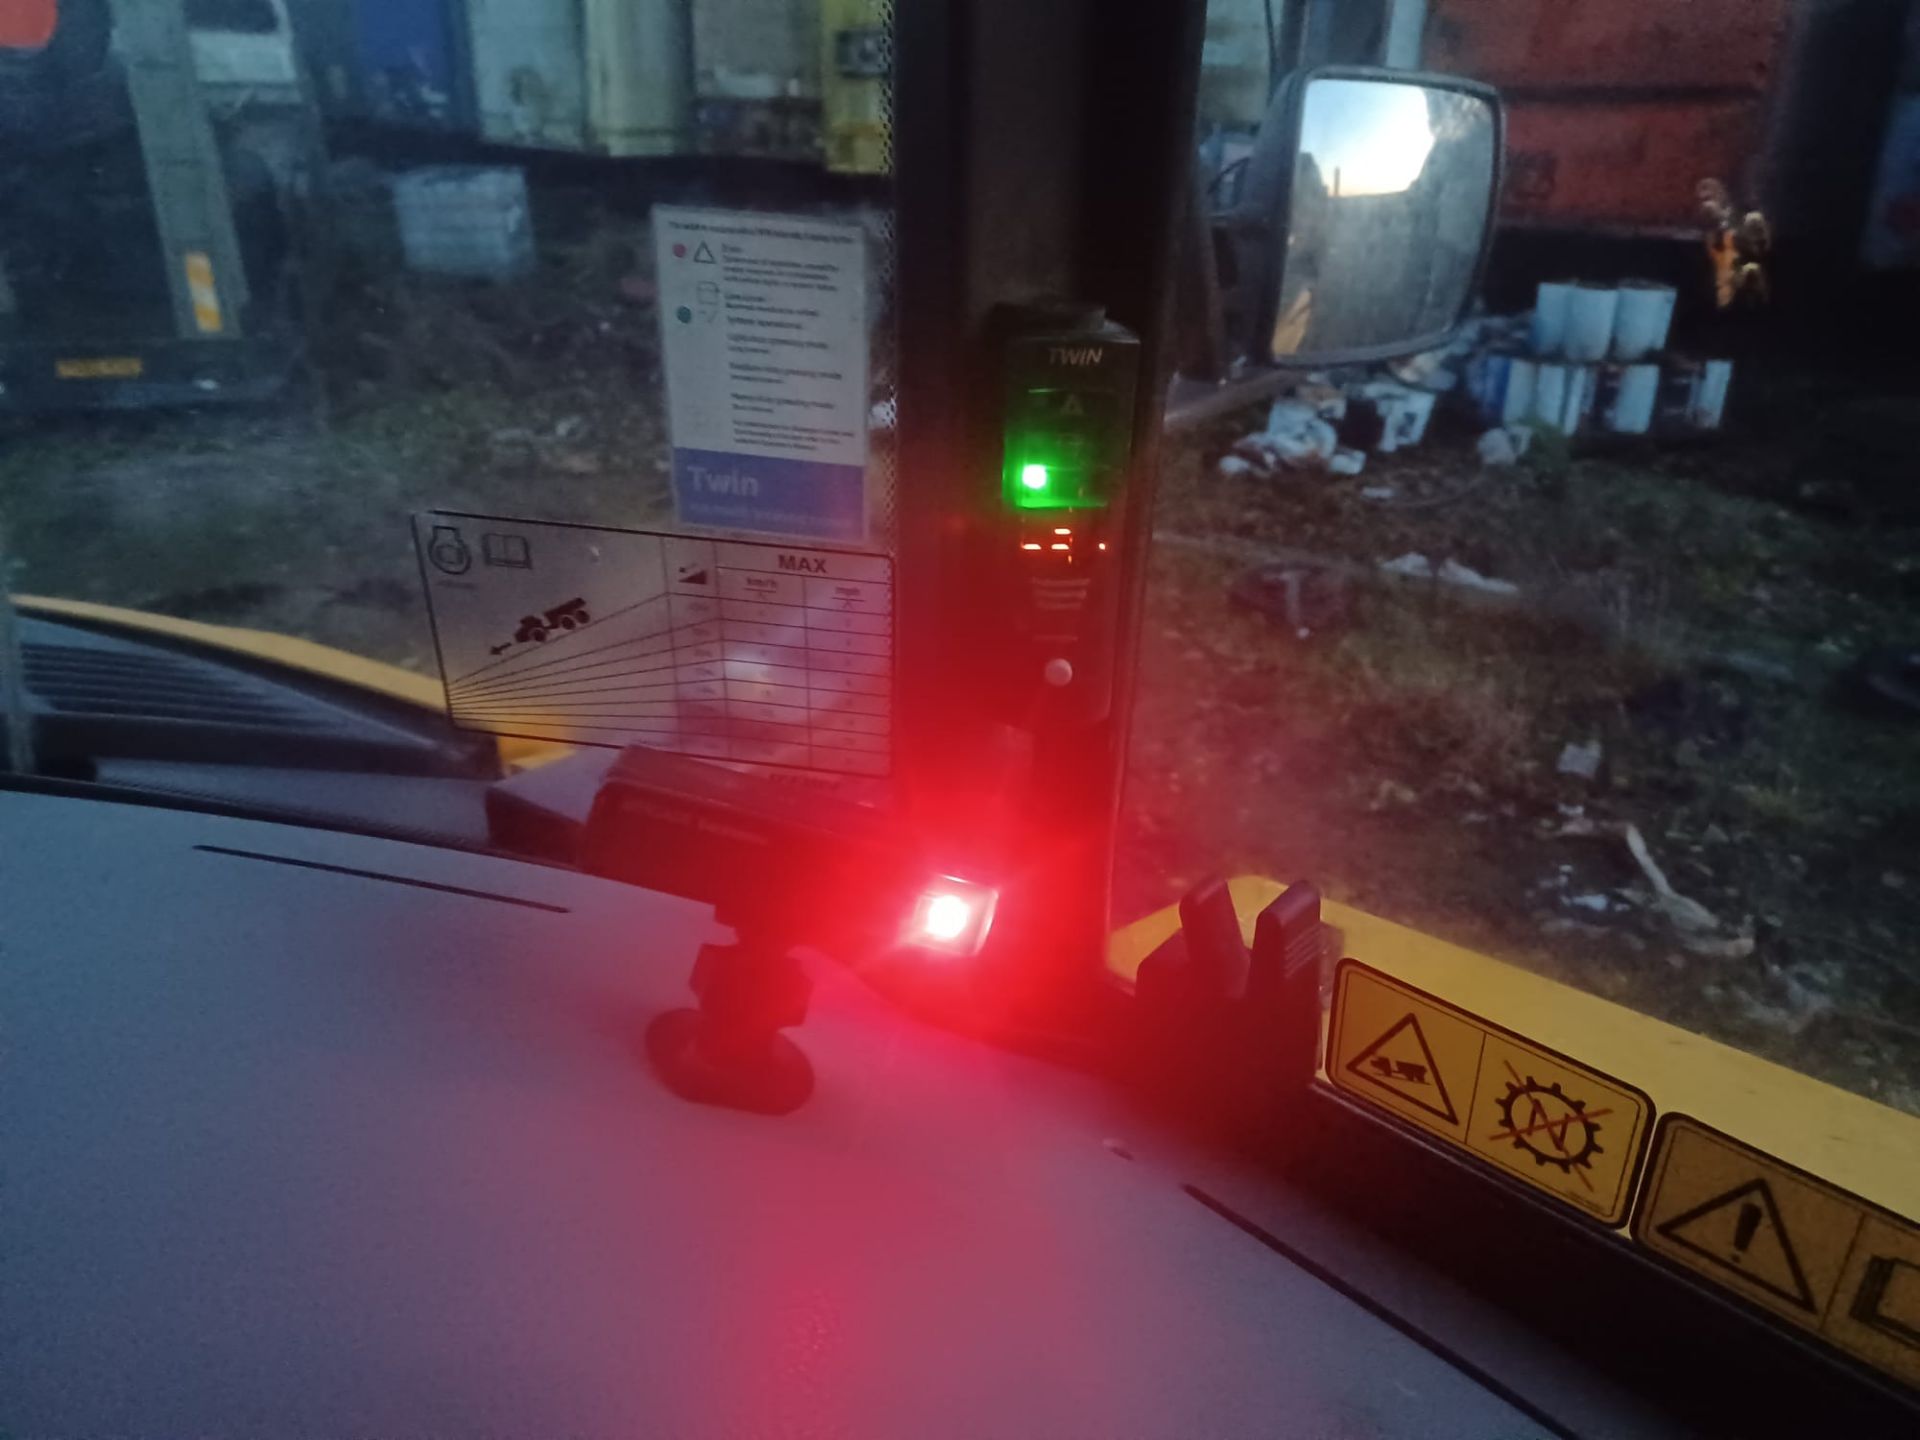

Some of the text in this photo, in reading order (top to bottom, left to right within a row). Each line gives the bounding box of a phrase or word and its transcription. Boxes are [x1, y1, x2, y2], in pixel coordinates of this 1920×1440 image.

[1047, 346, 1104, 366] TWIN
[687, 464, 760, 498] Twin
[777, 554, 828, 574] MAX
